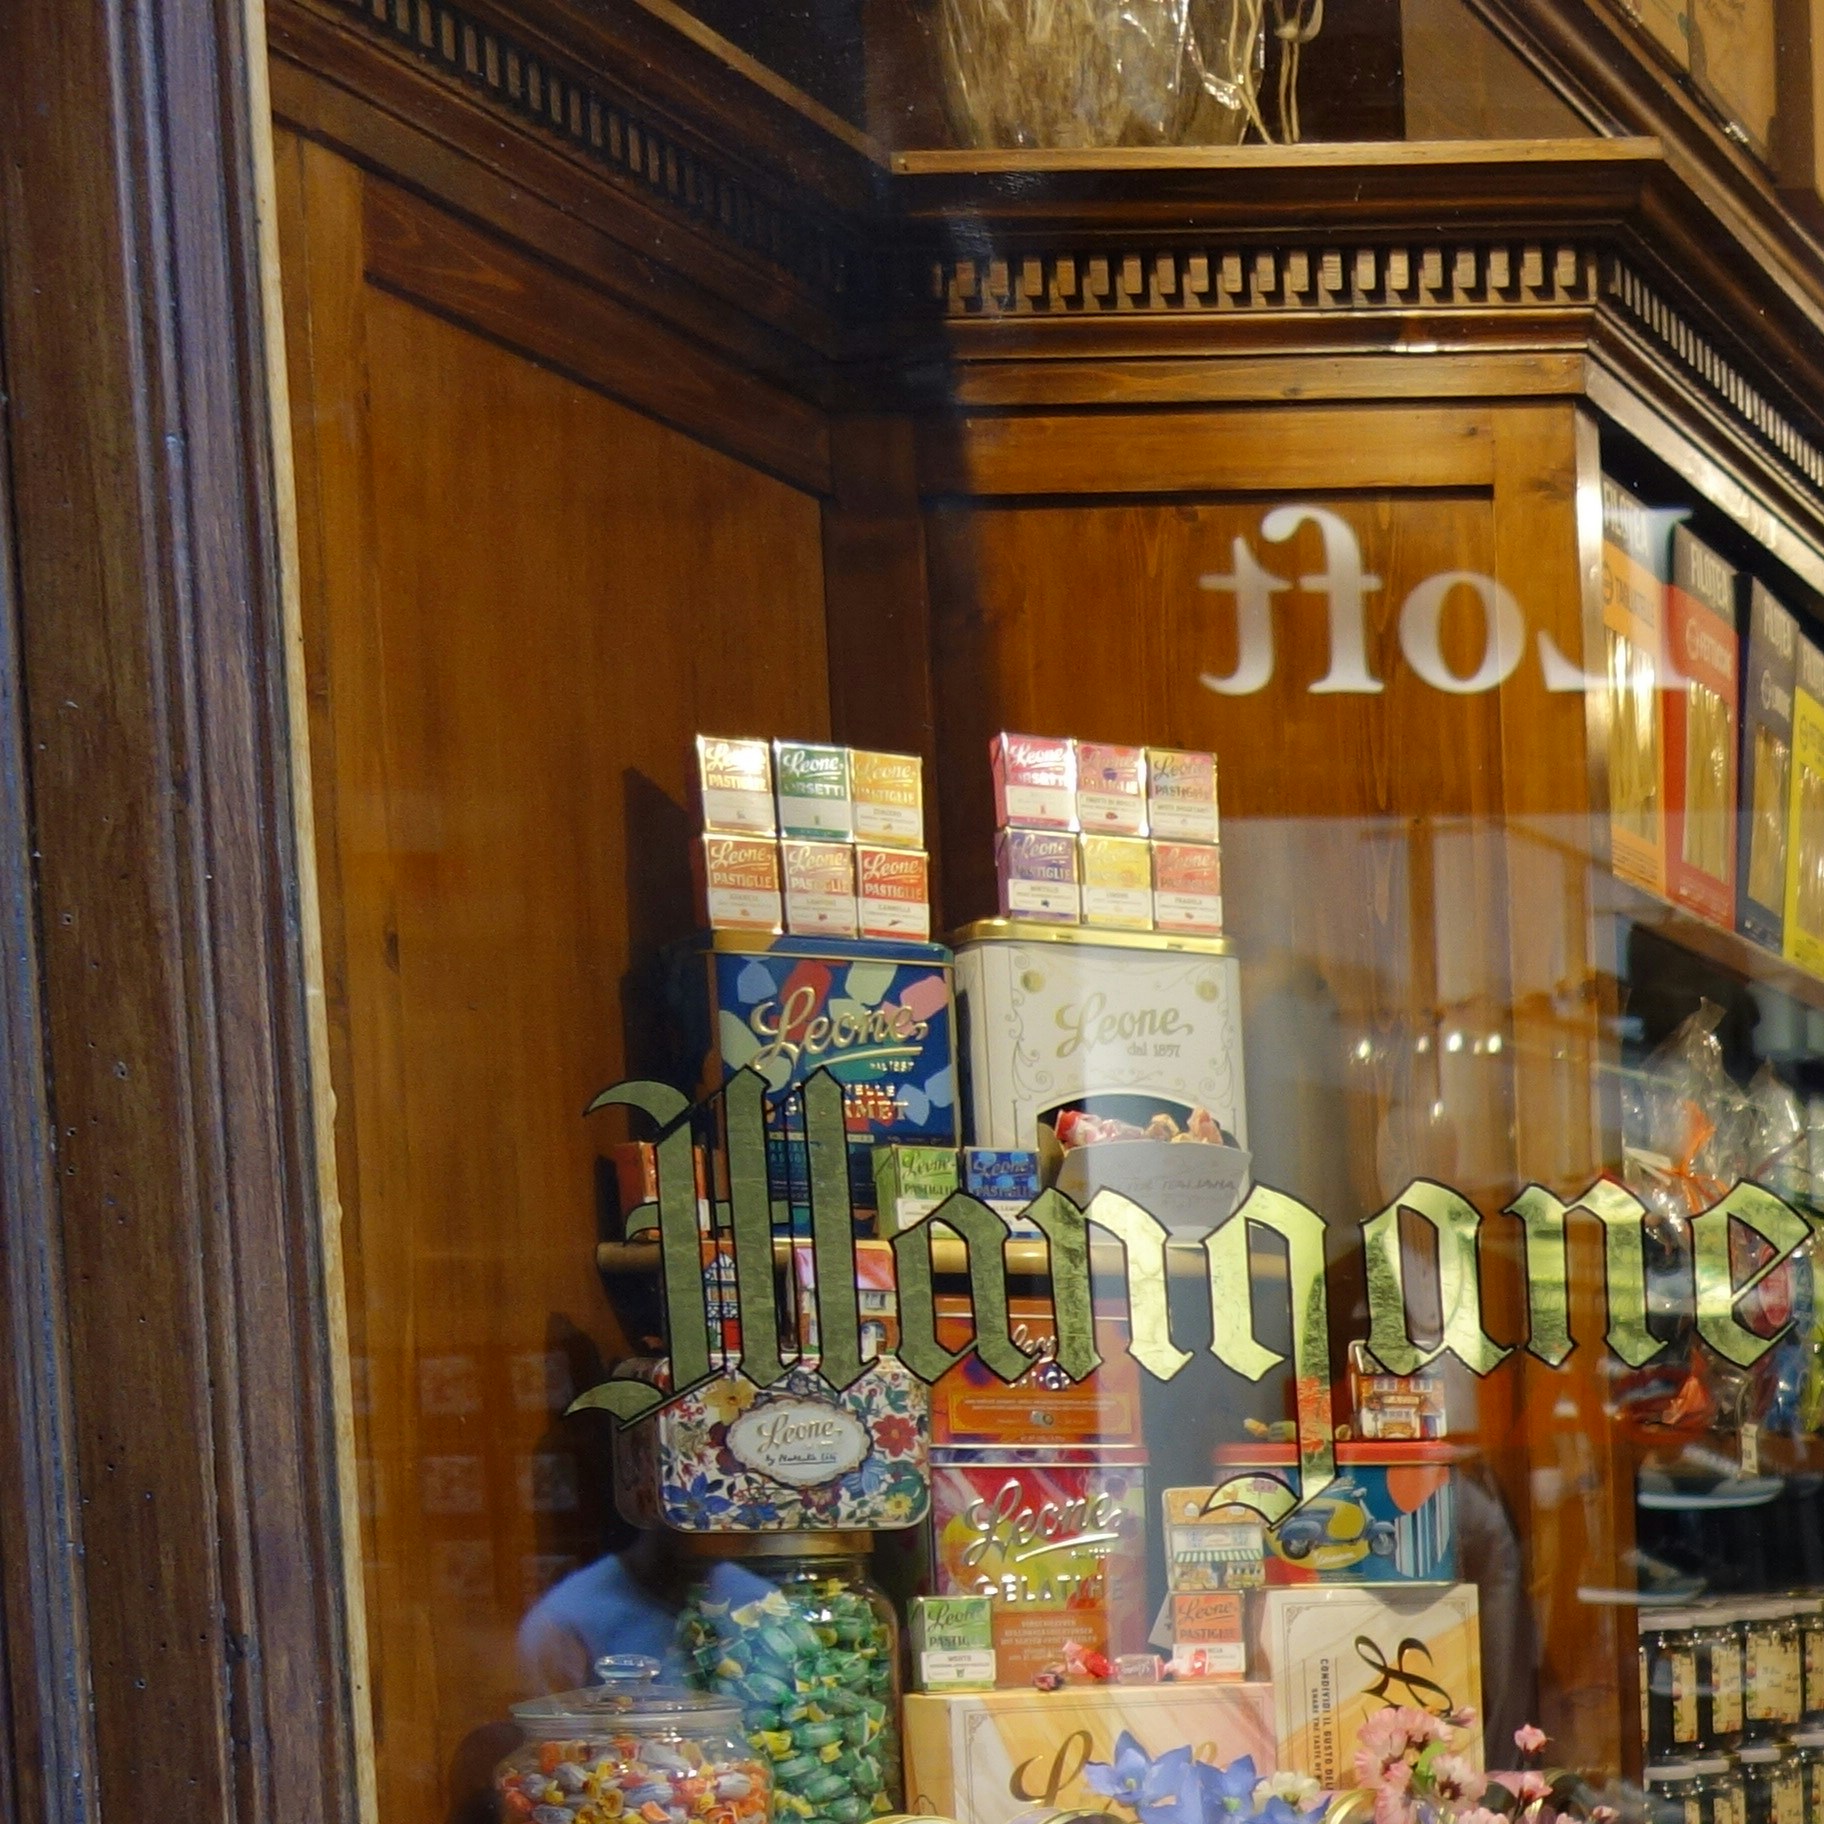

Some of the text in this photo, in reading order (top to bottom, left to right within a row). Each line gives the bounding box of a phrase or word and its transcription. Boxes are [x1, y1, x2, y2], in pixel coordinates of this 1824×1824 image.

[711, 842, 772, 868] Leone
[864, 853, 923, 880] Leone
[751, 986, 928, 1070] Leone
[1055, 992, 1194, 1058] Leone
[1127, 1043, 1181, 1058] dal 1857
[757, 1411, 843, 1453] Leone
[963, 1479, 1126, 1567] Leone
[1320, 1658, 1333, 1765] CONDIVIDI GUSTO
